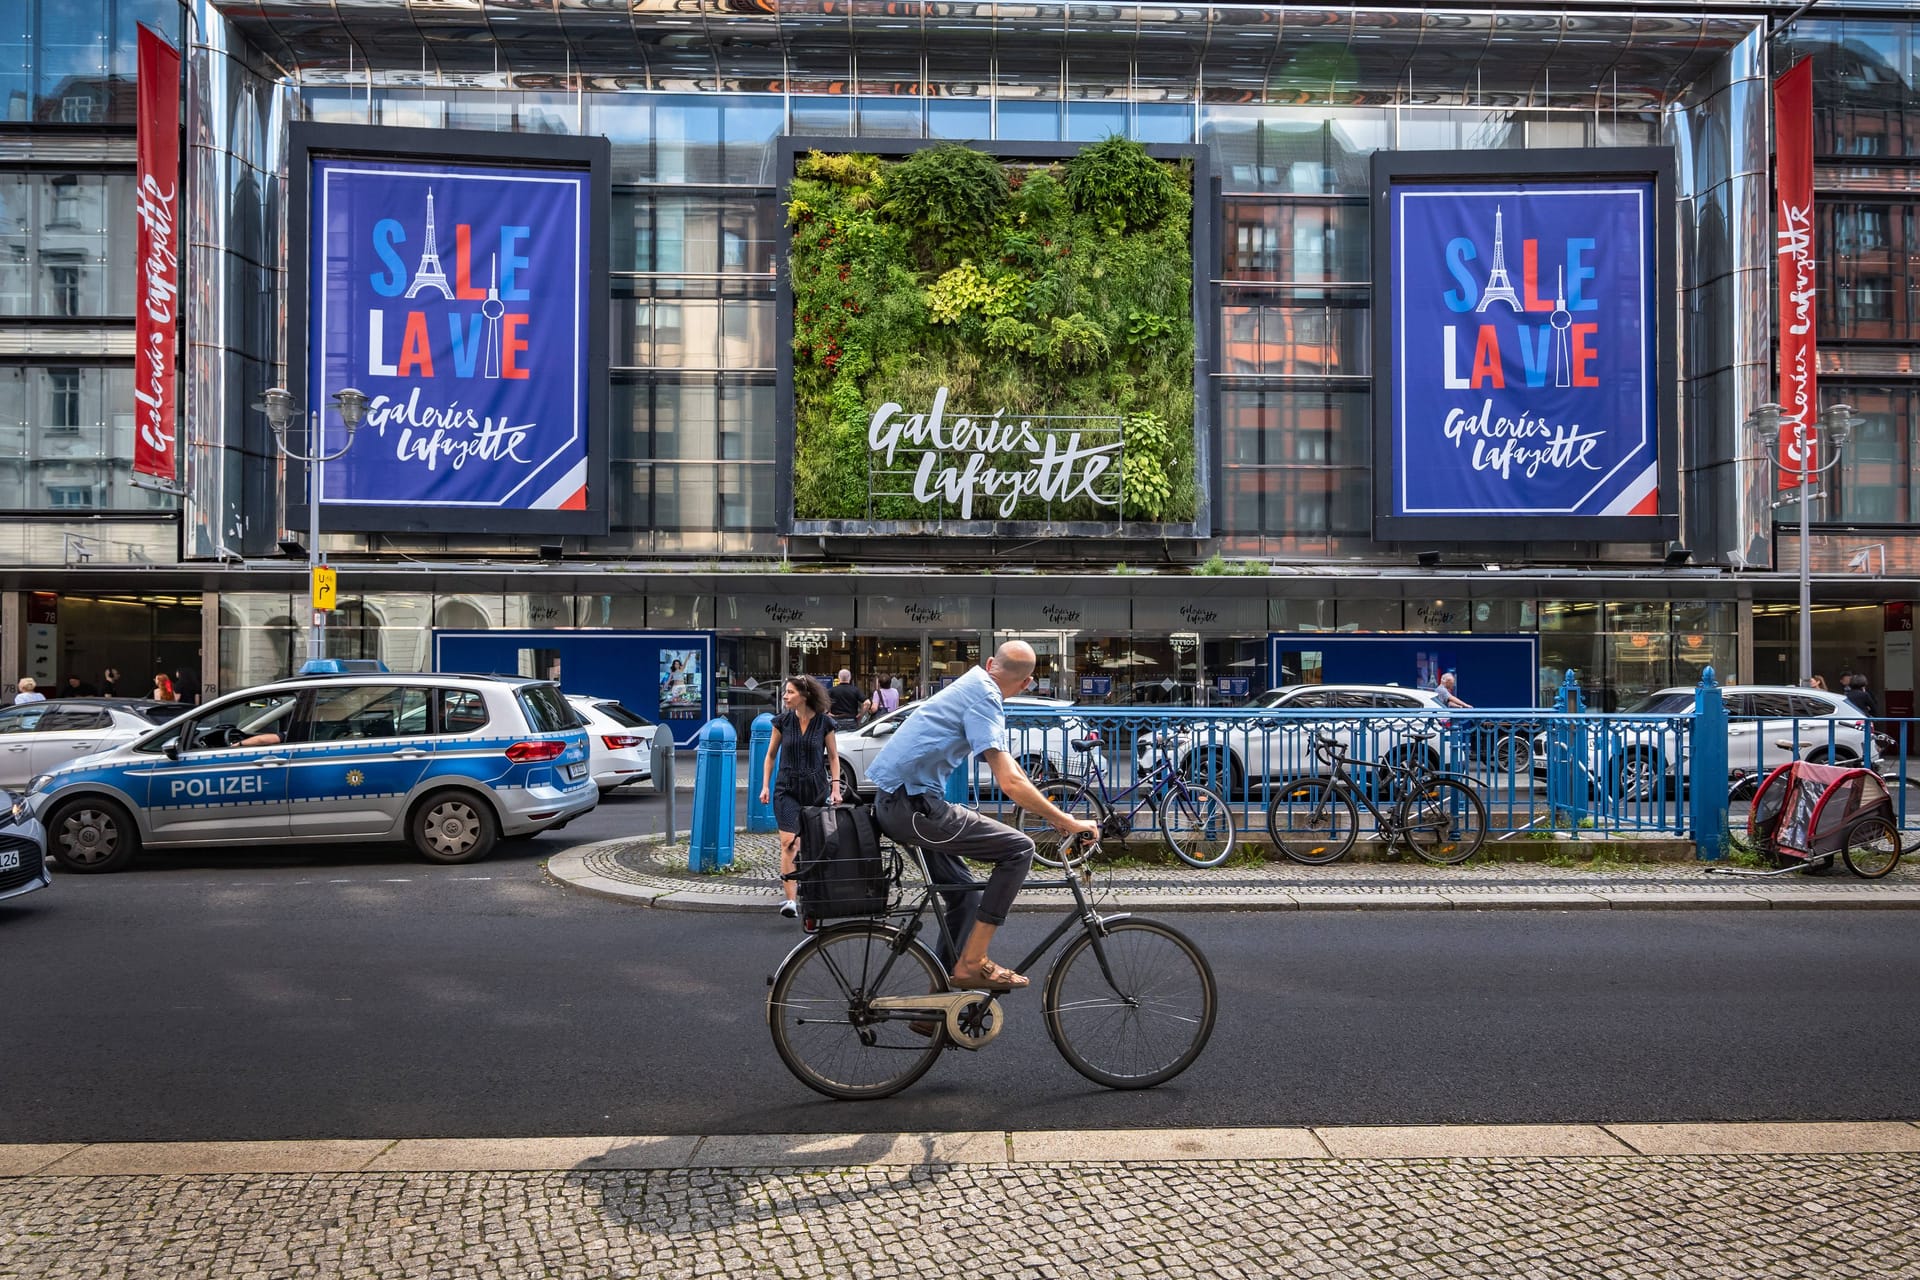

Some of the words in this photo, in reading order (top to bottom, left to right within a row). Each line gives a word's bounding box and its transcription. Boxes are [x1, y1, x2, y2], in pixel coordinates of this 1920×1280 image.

[137, 160, 177, 324] Lafayette
[370, 188, 530, 300] SALE
[1443, 205, 1598, 312] SALE
[1778, 190, 1816, 334] Lafayette
[369, 309, 434, 377] LA
[1443, 324, 1505, 389] LA
[135, 332, 174, 452] Galeries
[367, 387, 479, 437] Galeries
[1444, 399, 1551, 448] Galeries
[1778, 344, 1817, 460] Galeries
[397, 417, 537, 471] Lafayette
[868, 387, 1040, 467] Galeries
[1472, 424, 1607, 480] Lafayette
[913, 433, 1125, 519] Lafayette
[44, 611, 56, 623] 78
[1901, 619, 1912, 630] 76
[3, 684, 16, 693] 78
[204, 684, 216, 693] 78
[171, 775, 262, 798] POLIZEI
